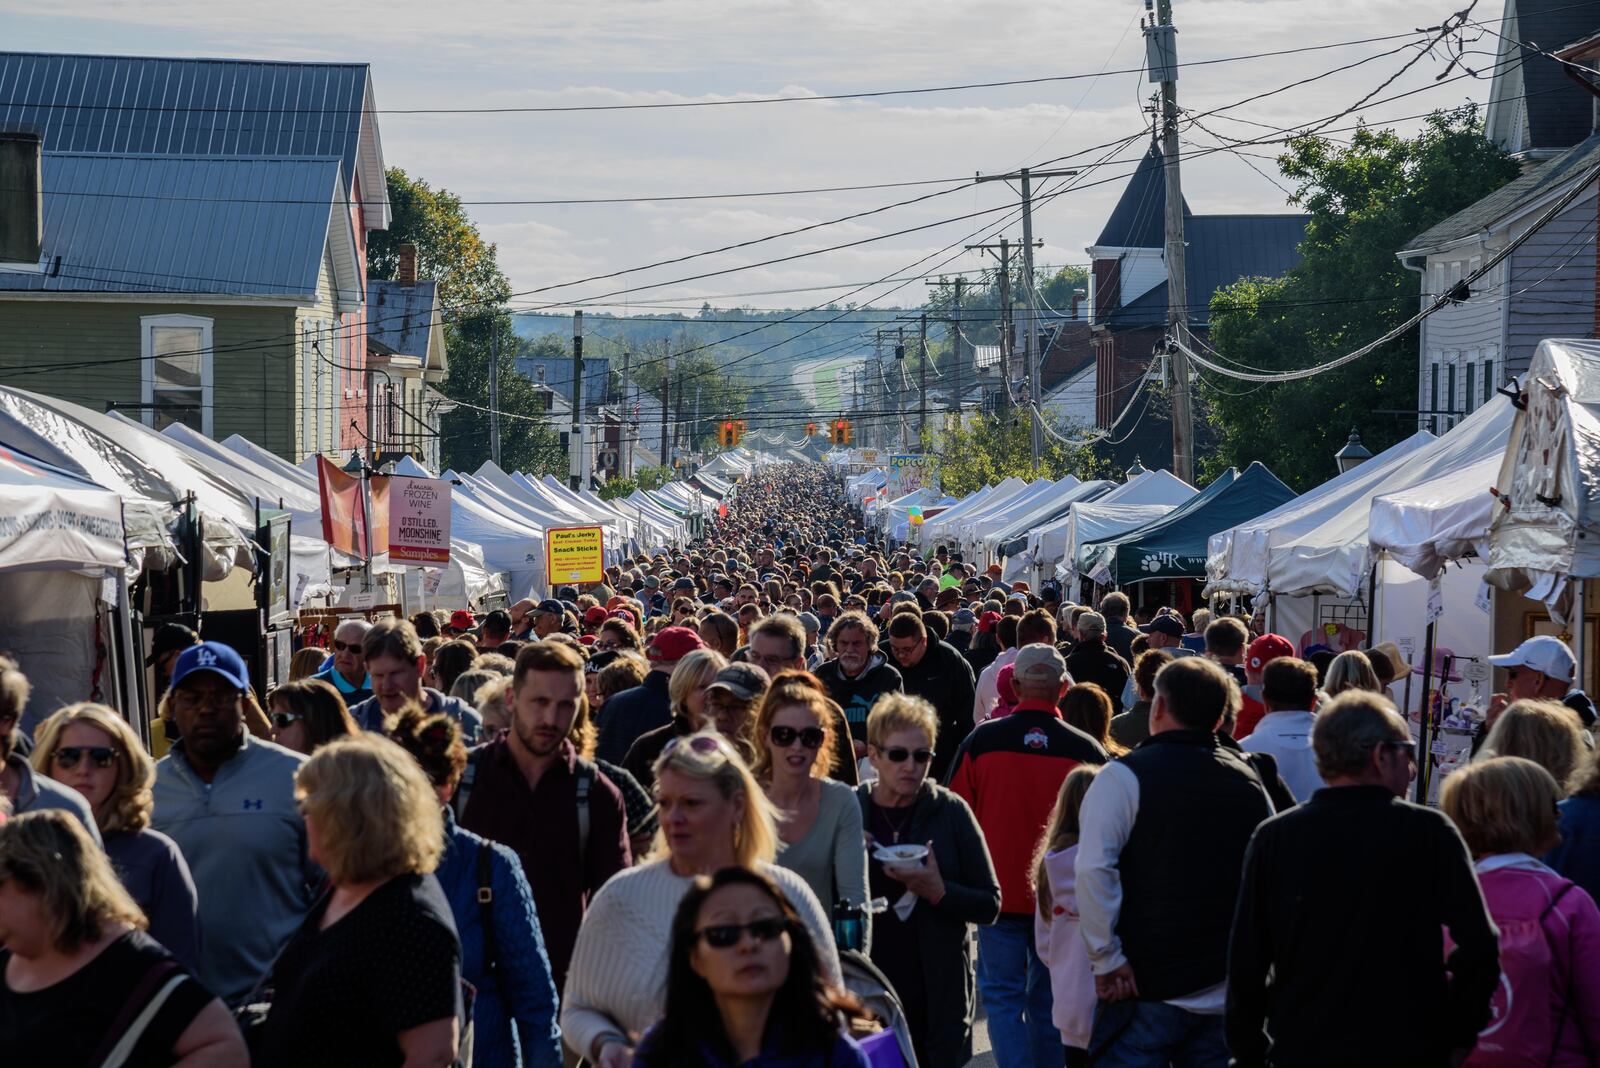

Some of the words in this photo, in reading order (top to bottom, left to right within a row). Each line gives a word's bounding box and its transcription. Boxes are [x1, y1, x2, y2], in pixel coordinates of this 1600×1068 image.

[403, 489, 438, 500] FROZEN
[409, 500, 432, 509] WINE
[399, 527, 442, 541] MOONSHINE
[400, 546, 439, 560] Samples
[197, 647, 217, 666] LA
